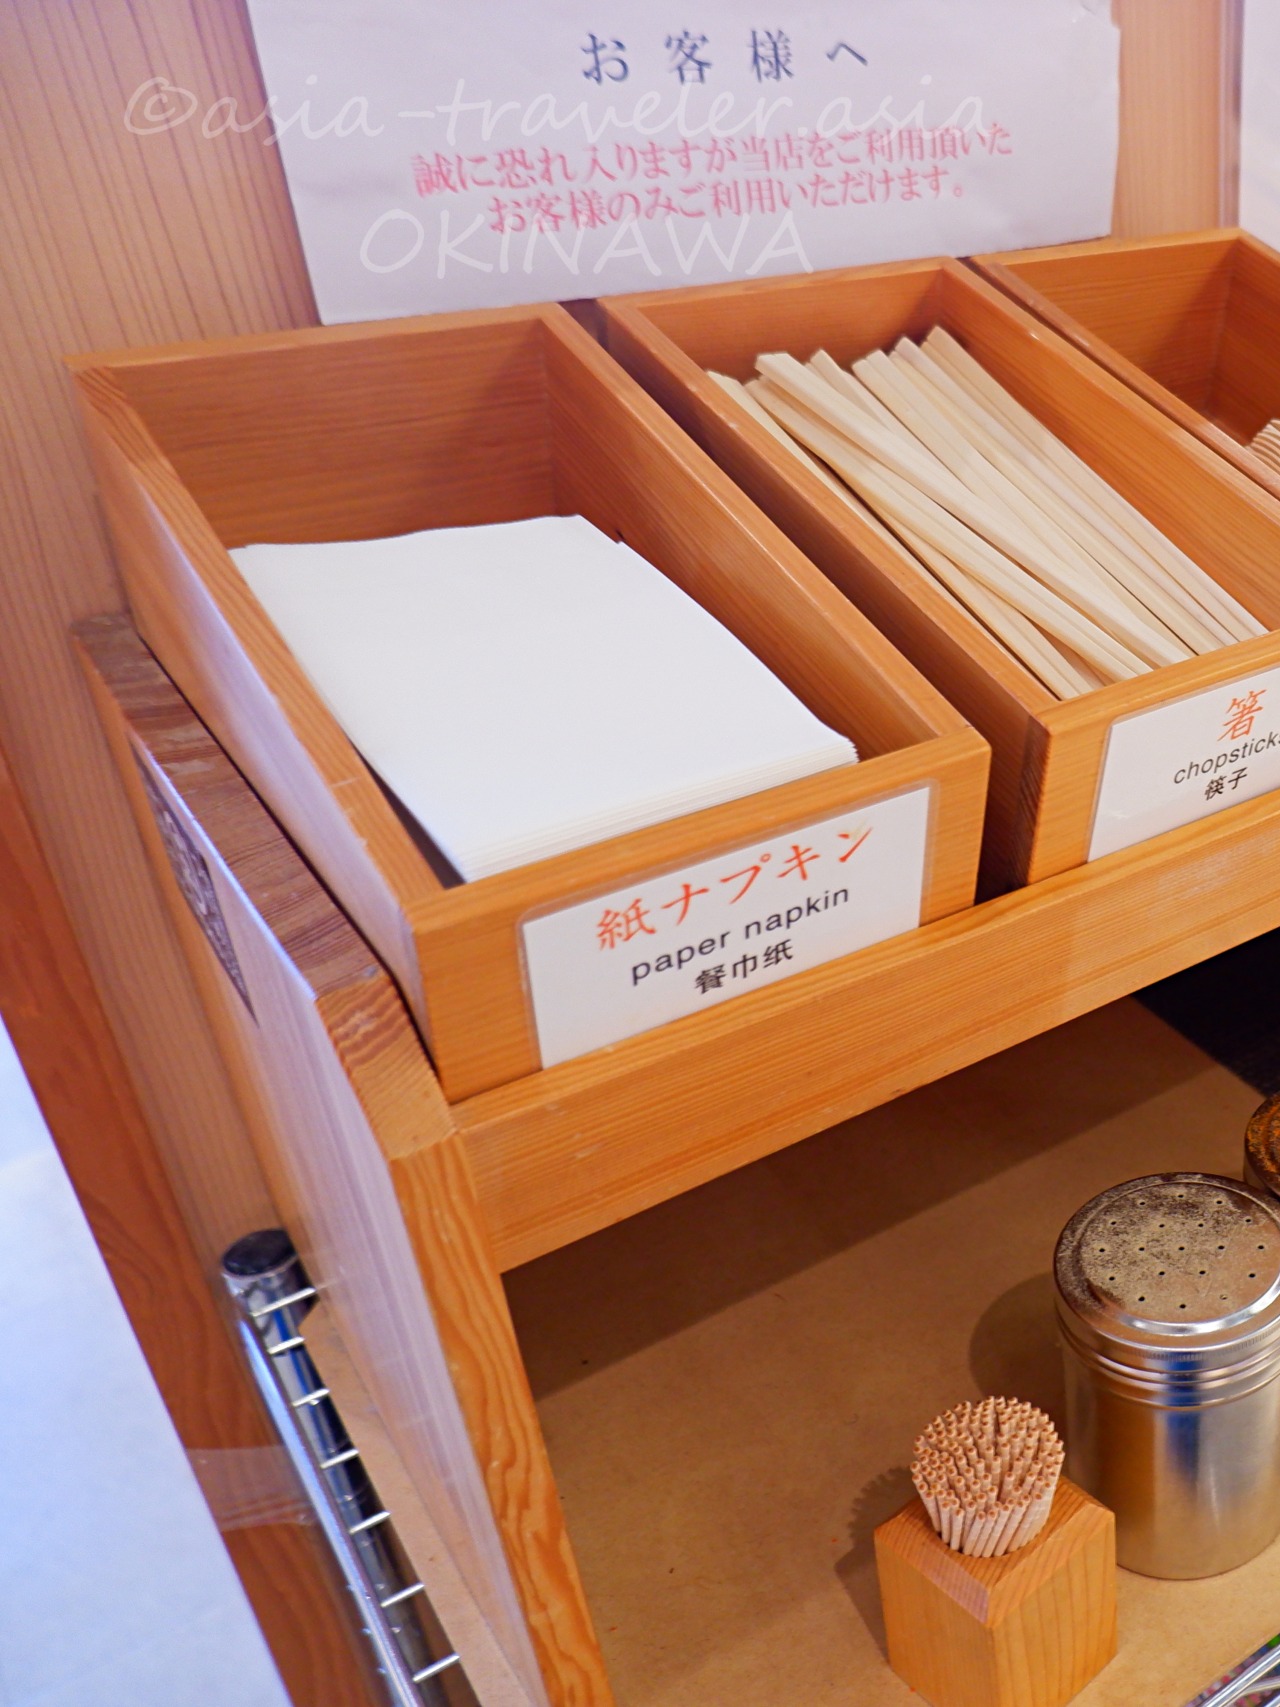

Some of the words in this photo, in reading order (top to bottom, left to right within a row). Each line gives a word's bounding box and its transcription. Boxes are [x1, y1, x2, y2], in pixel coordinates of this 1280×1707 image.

[580, 29, 868, 85] お客様へ
[411, 123, 1013, 197] 誠に恐れ入りますが当店をご利用頂いた
[489, 165, 964, 233] お客様のみご利用いただけます。
[1217, 688, 1267, 741] 箸
[1204, 767, 1248, 801] 筷子
[595, 826, 873, 950] 紙ナプキン
[631, 931, 730, 986] paper
[745, 888, 849, 939] napkin
[694, 939, 794, 994] 餐巾纸
